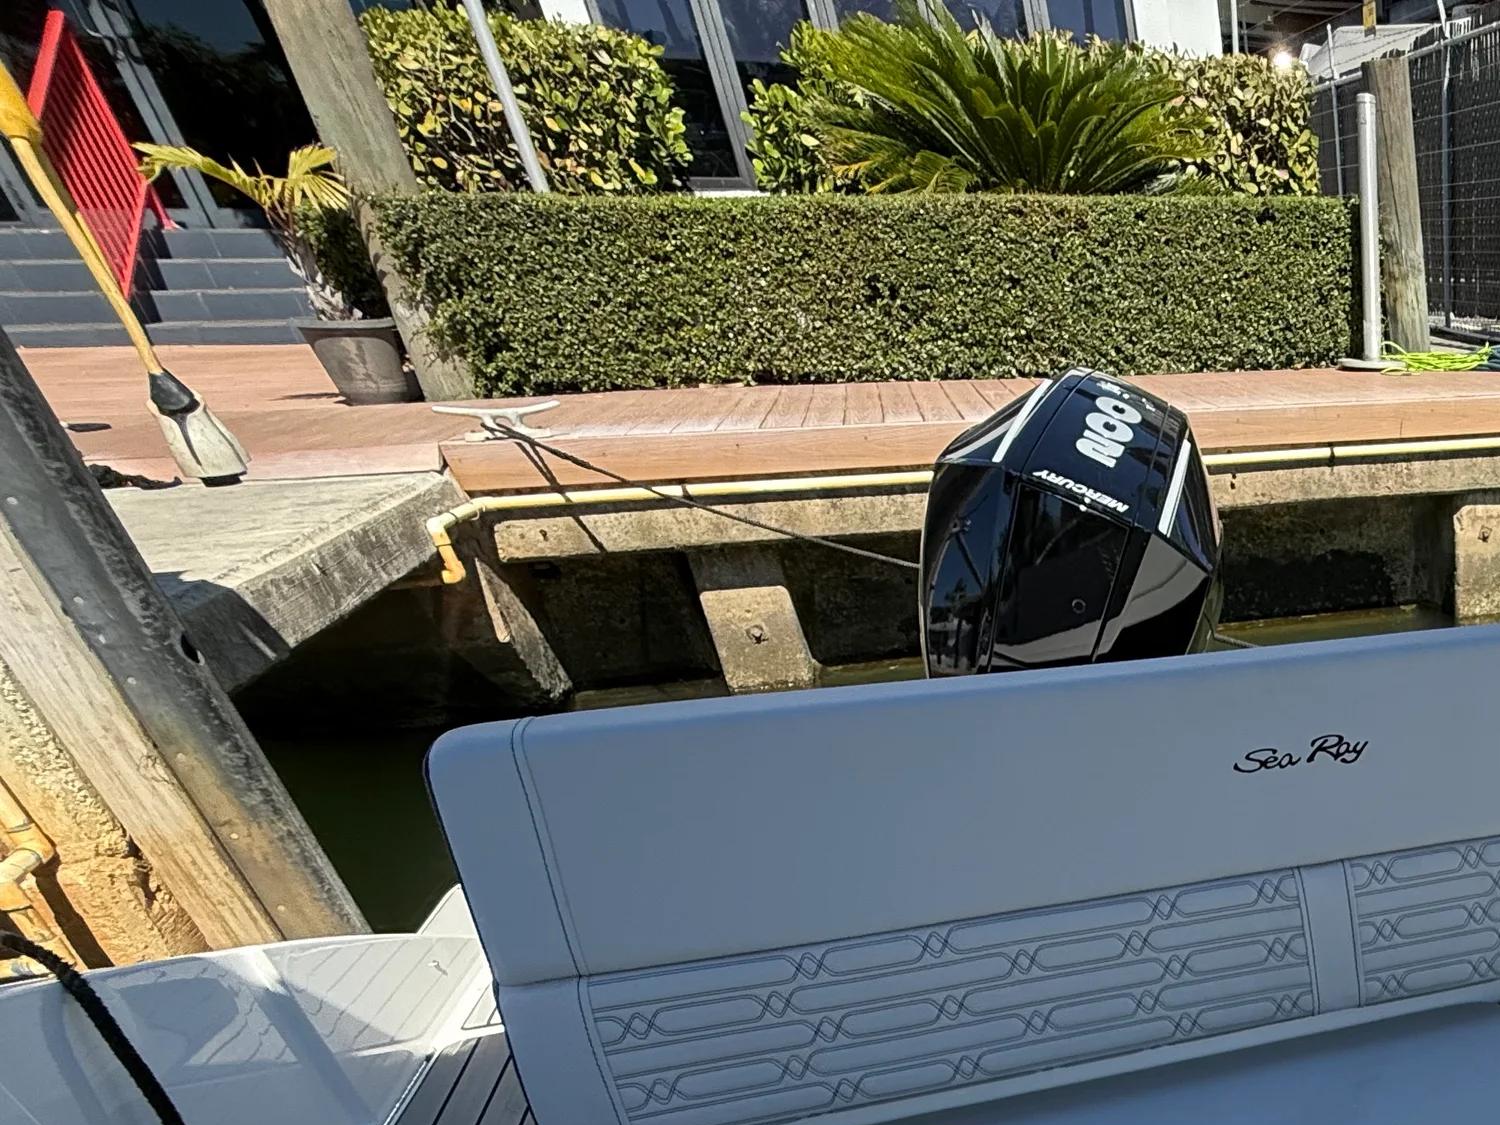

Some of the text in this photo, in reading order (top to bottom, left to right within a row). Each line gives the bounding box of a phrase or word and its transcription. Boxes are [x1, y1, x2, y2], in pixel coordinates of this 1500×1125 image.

[1076, 396, 1142, 468] 200
[1033, 469, 1129, 513] MERCURY
[1233, 734, 1369, 773] Sea Ray
